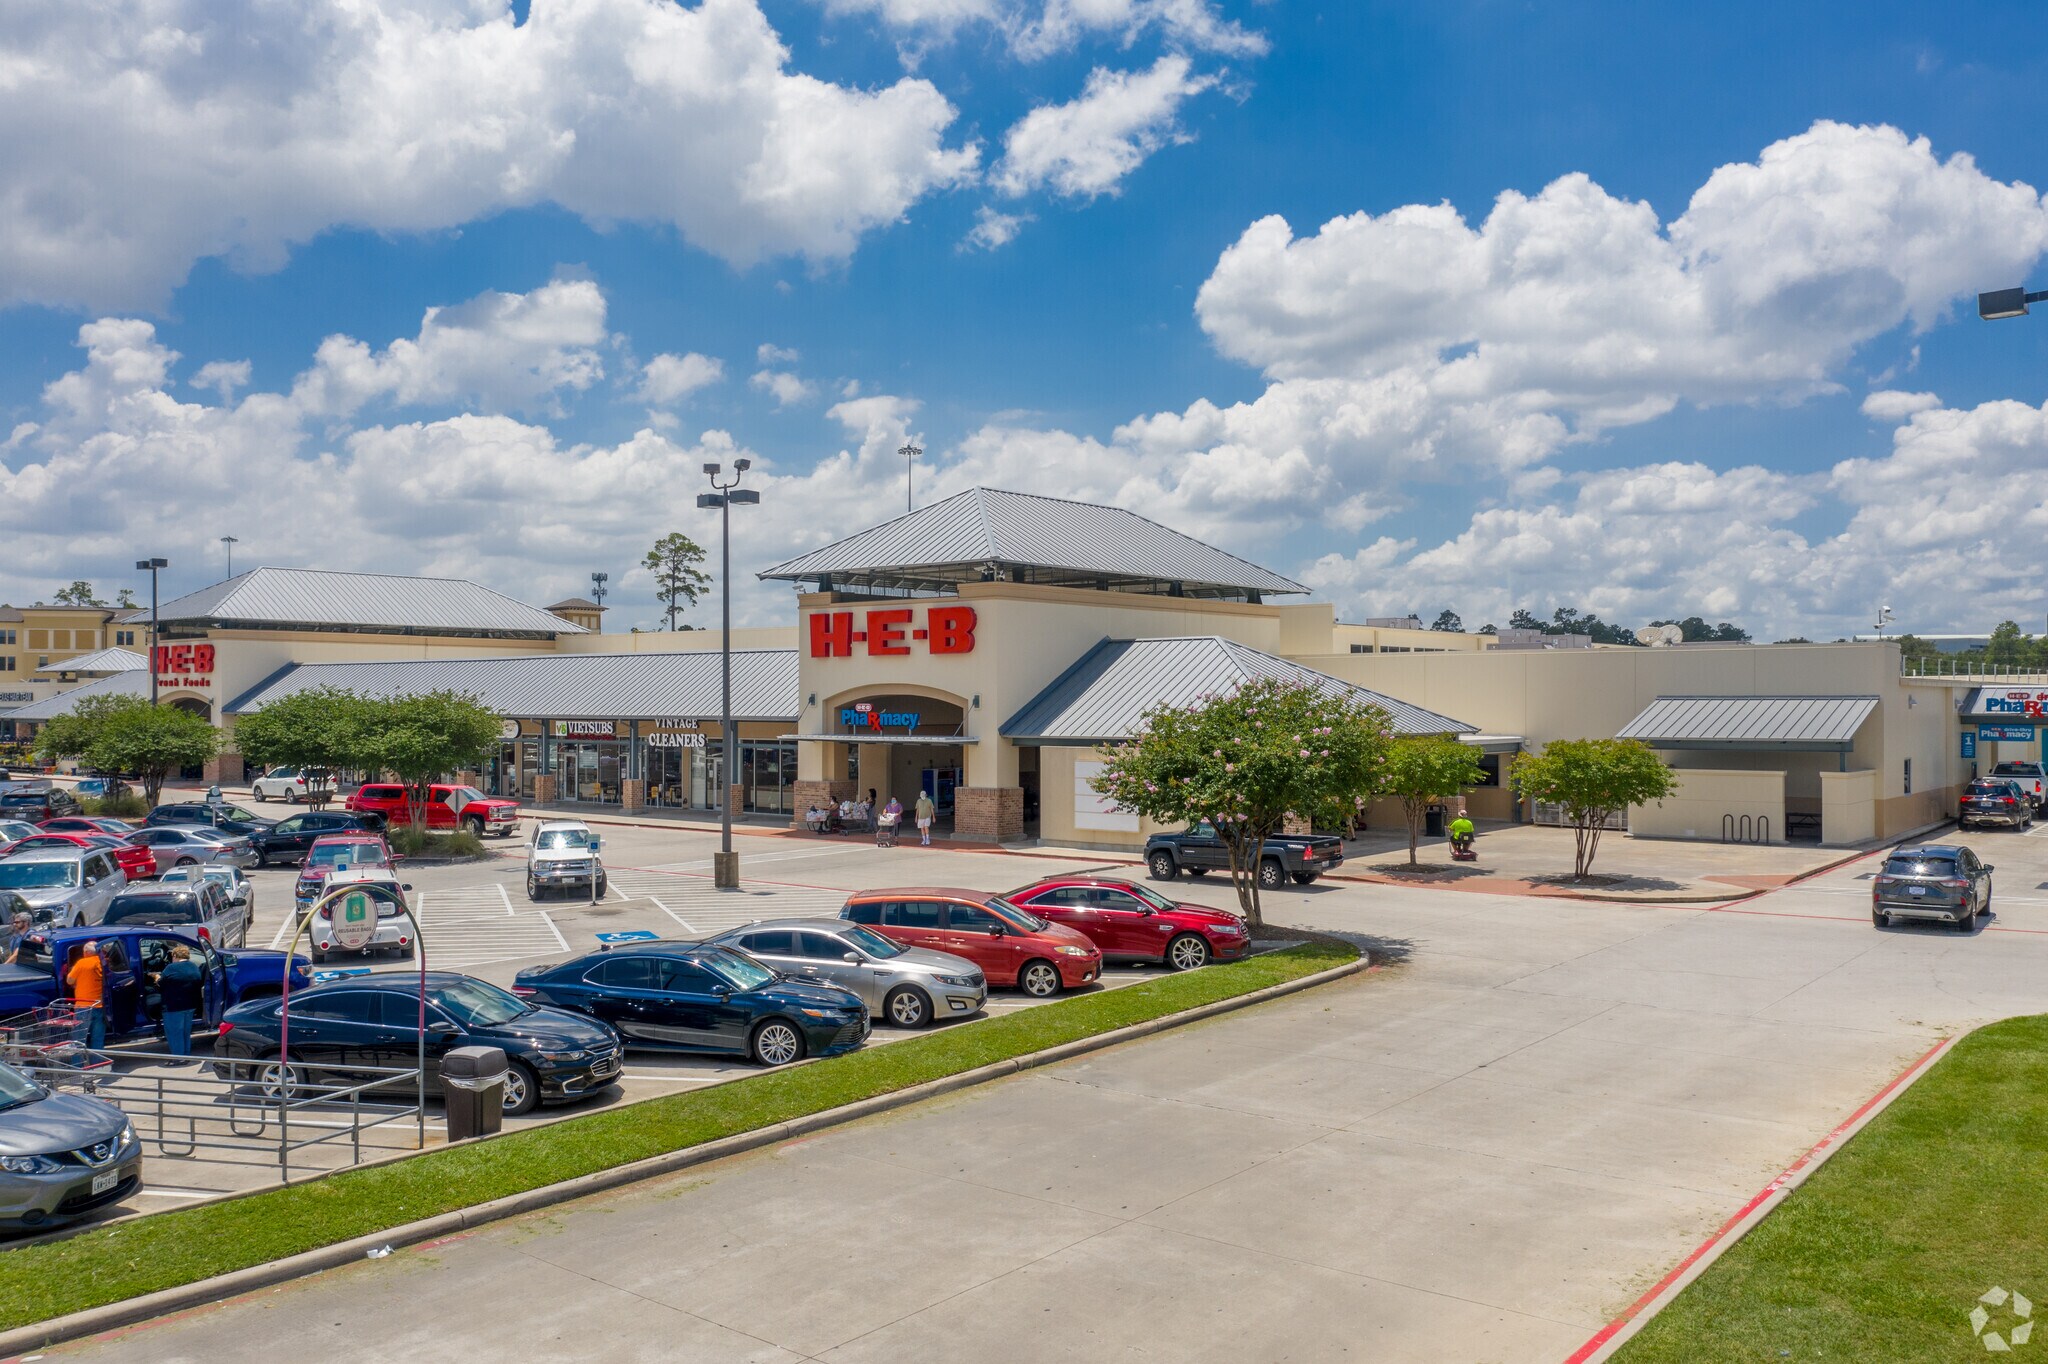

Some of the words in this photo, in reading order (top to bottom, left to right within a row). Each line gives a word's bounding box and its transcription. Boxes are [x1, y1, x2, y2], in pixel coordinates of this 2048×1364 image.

[809, 606, 978, 658] H-E-B
[149, 644, 215, 674] H-E-B
[157, 677, 179, 687] resh
[183, 677, 211, 687] Foods
[568, 721, 614, 734] VIETSUBS
[655, 718, 698, 728] VINTAGE
[649, 733, 705, 747] CLEANERS
[1965, 736, 1972, 745] 1
